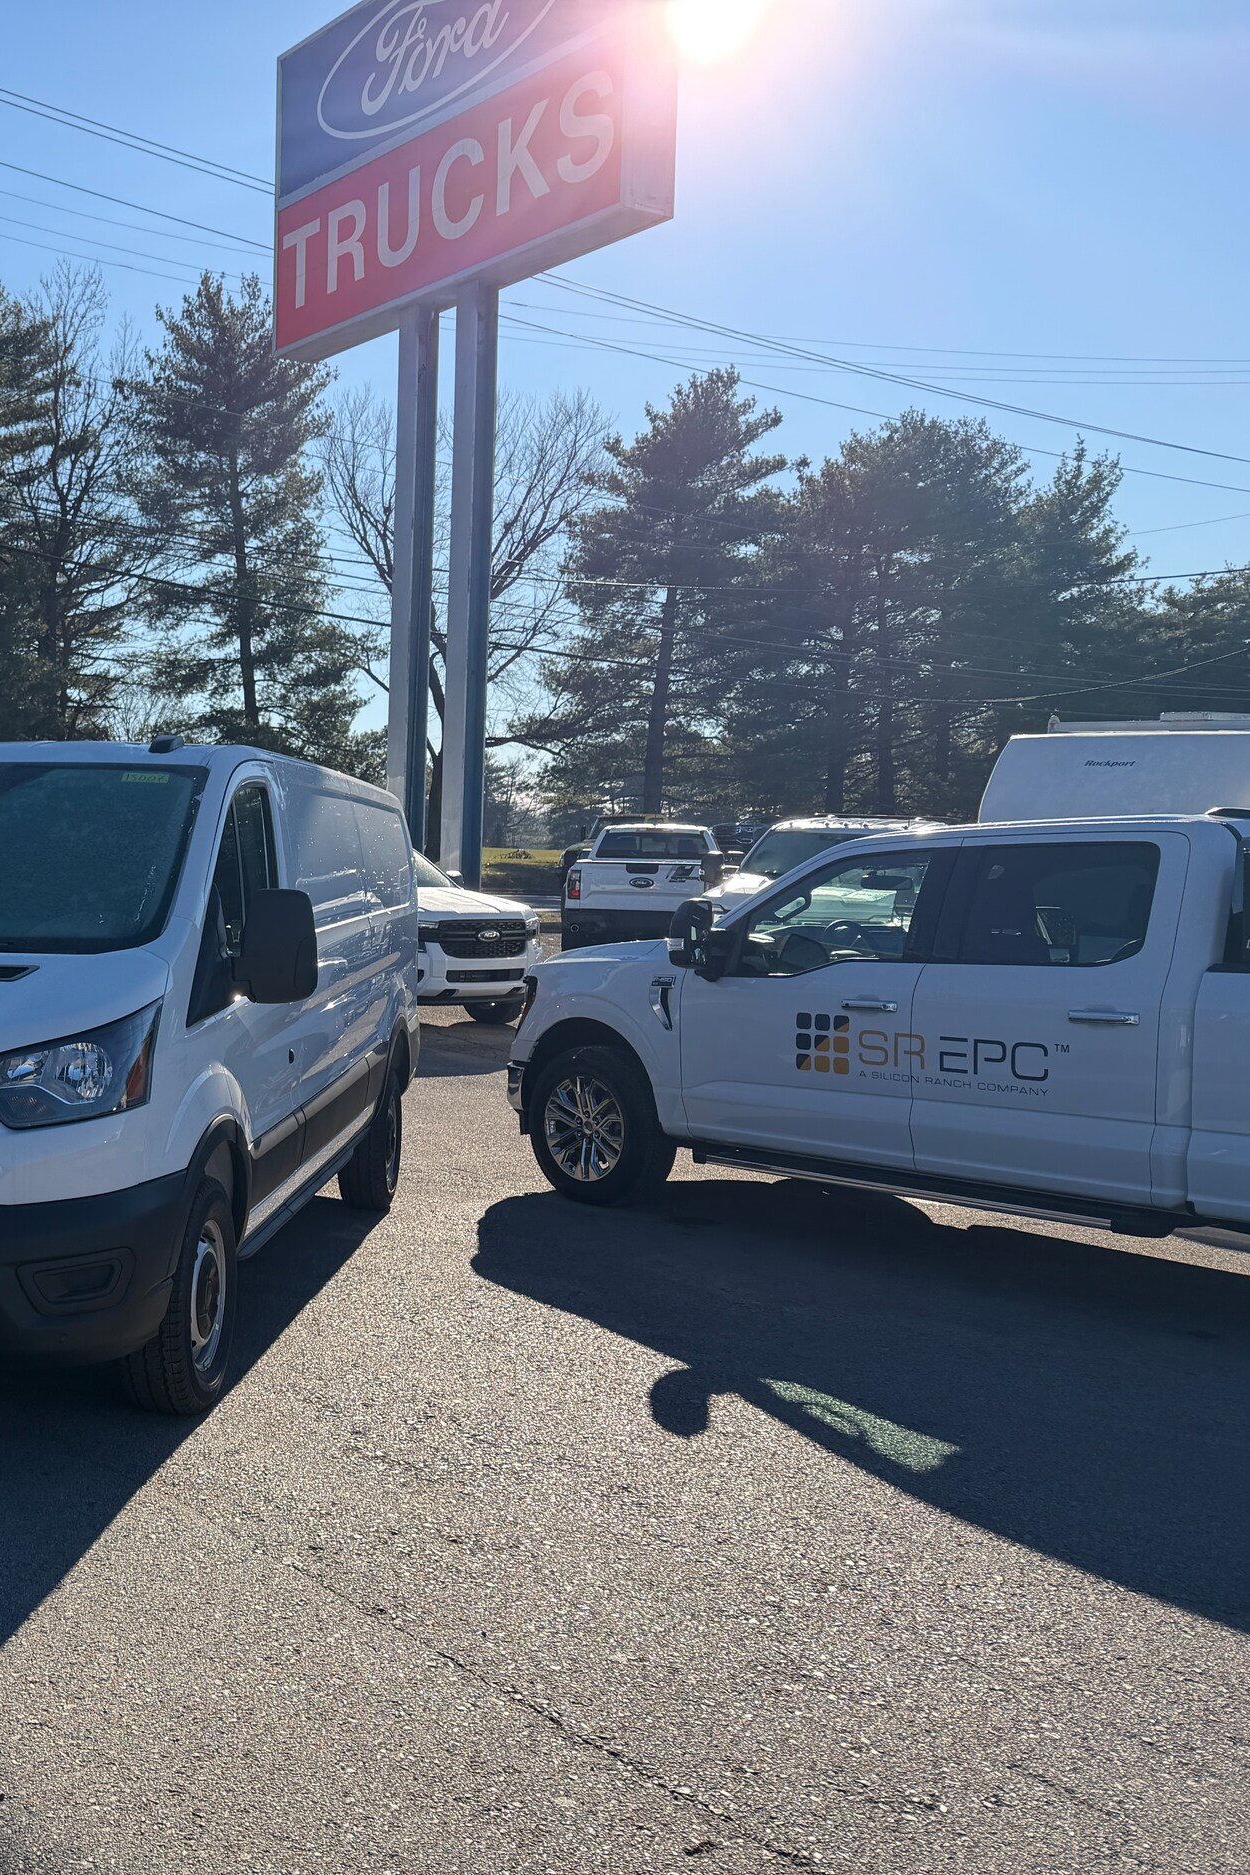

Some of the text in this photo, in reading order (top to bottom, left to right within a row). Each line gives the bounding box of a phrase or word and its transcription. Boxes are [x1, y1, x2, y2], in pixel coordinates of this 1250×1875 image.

[361, 0, 510, 116] Ford
[282, 70, 615, 310] TRUCKS
[1084, 759, 1136, 768] Rockport
[858, 1030, 926, 1070] SR
[939, 1035, 1049, 1082] EPC
[858, 1070, 1049, 1096] A SILICON RANCH COMPANY
